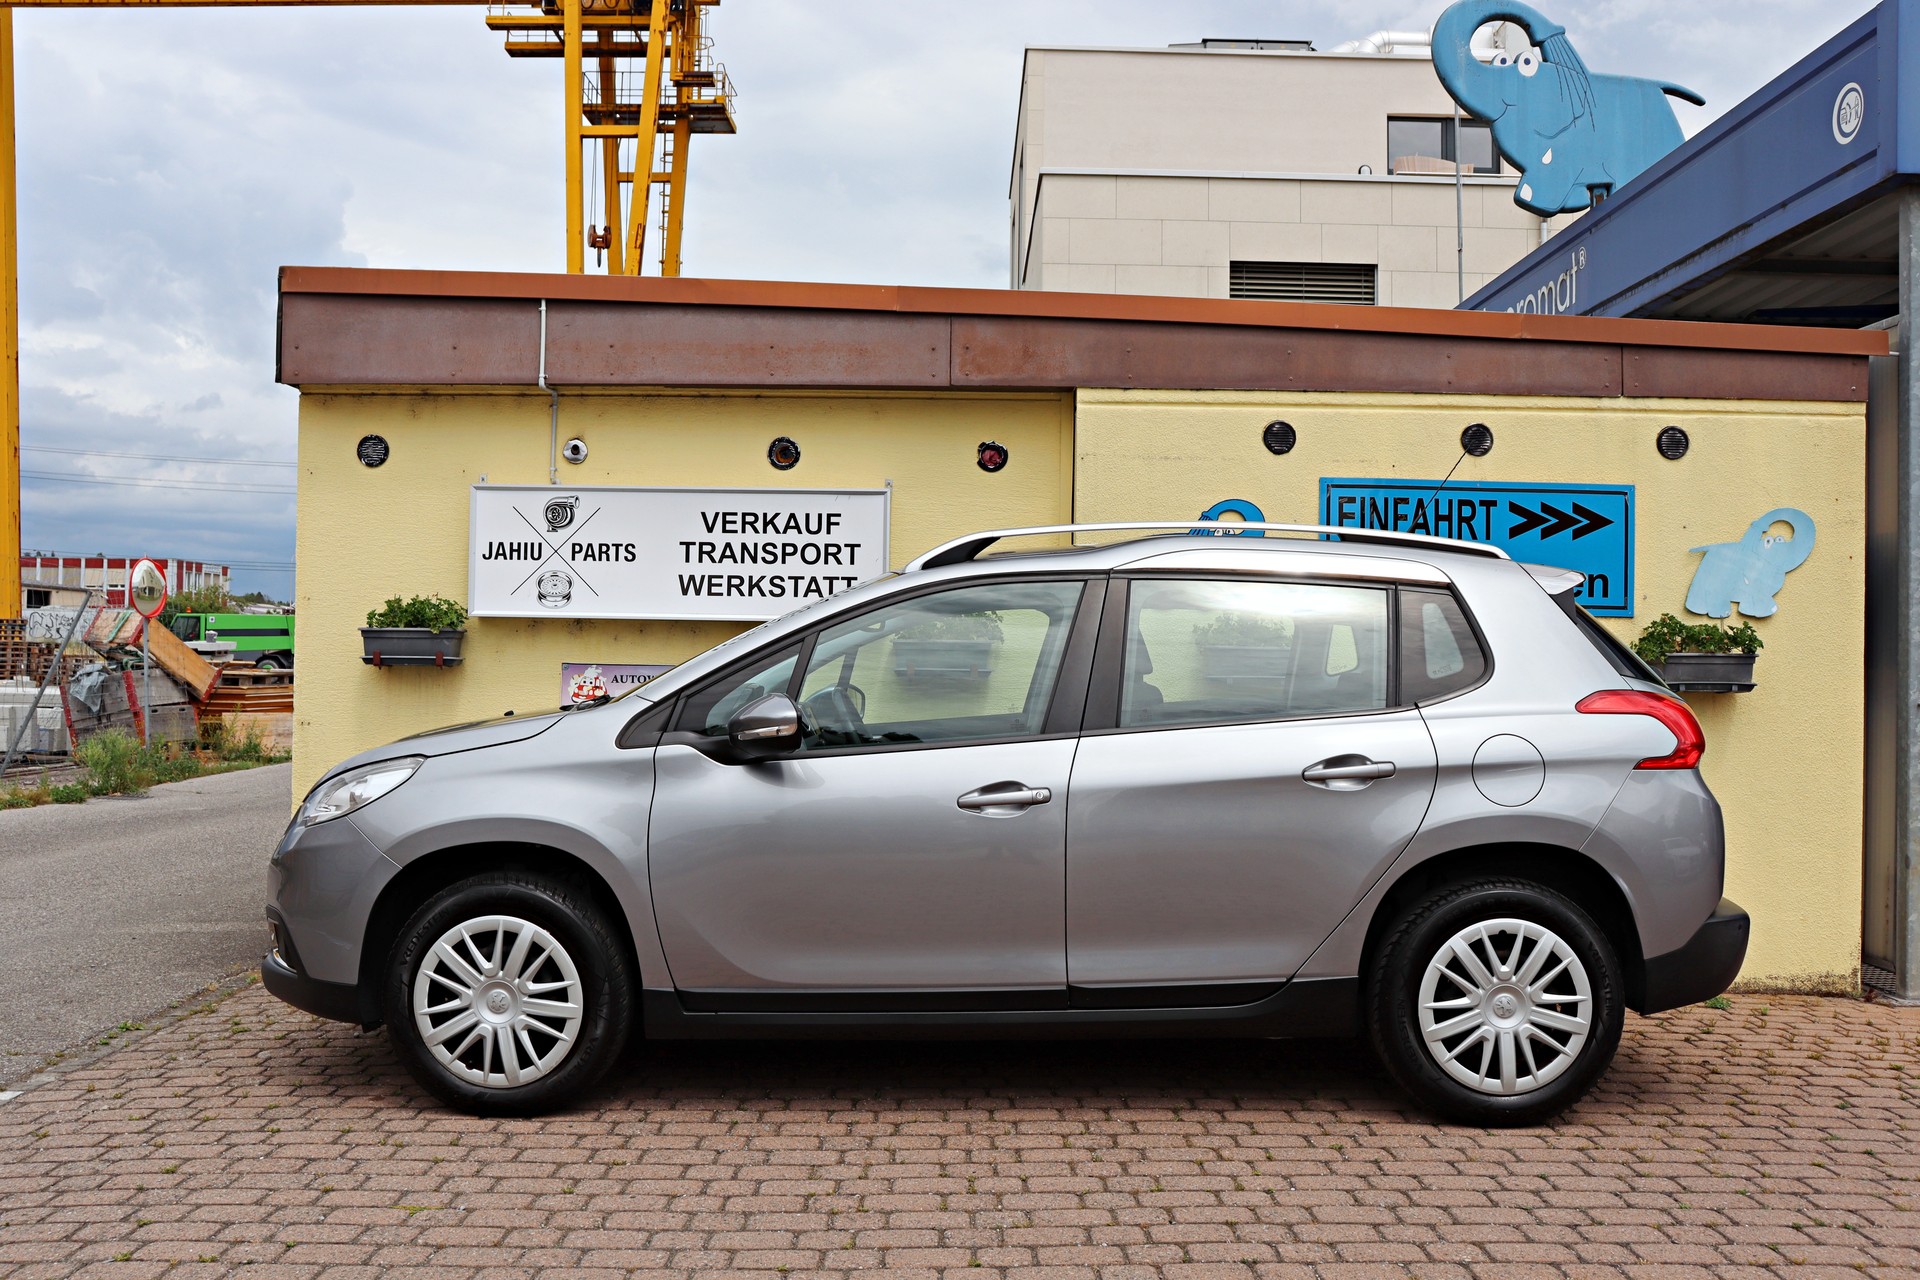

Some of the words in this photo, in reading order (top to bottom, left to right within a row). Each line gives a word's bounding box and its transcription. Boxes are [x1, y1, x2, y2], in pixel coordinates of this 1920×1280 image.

[700, 511, 842, 535] VERKAUF
[1338, 496, 1498, 541] EINFAHRT
[482, 541, 543, 561] JAHIU
[571, 542, 637, 562] PARTS
[679, 541, 862, 565] TRANSPORT
[678, 574, 858, 598] WERKSTATT
[611, 674, 655, 684] AUTO
